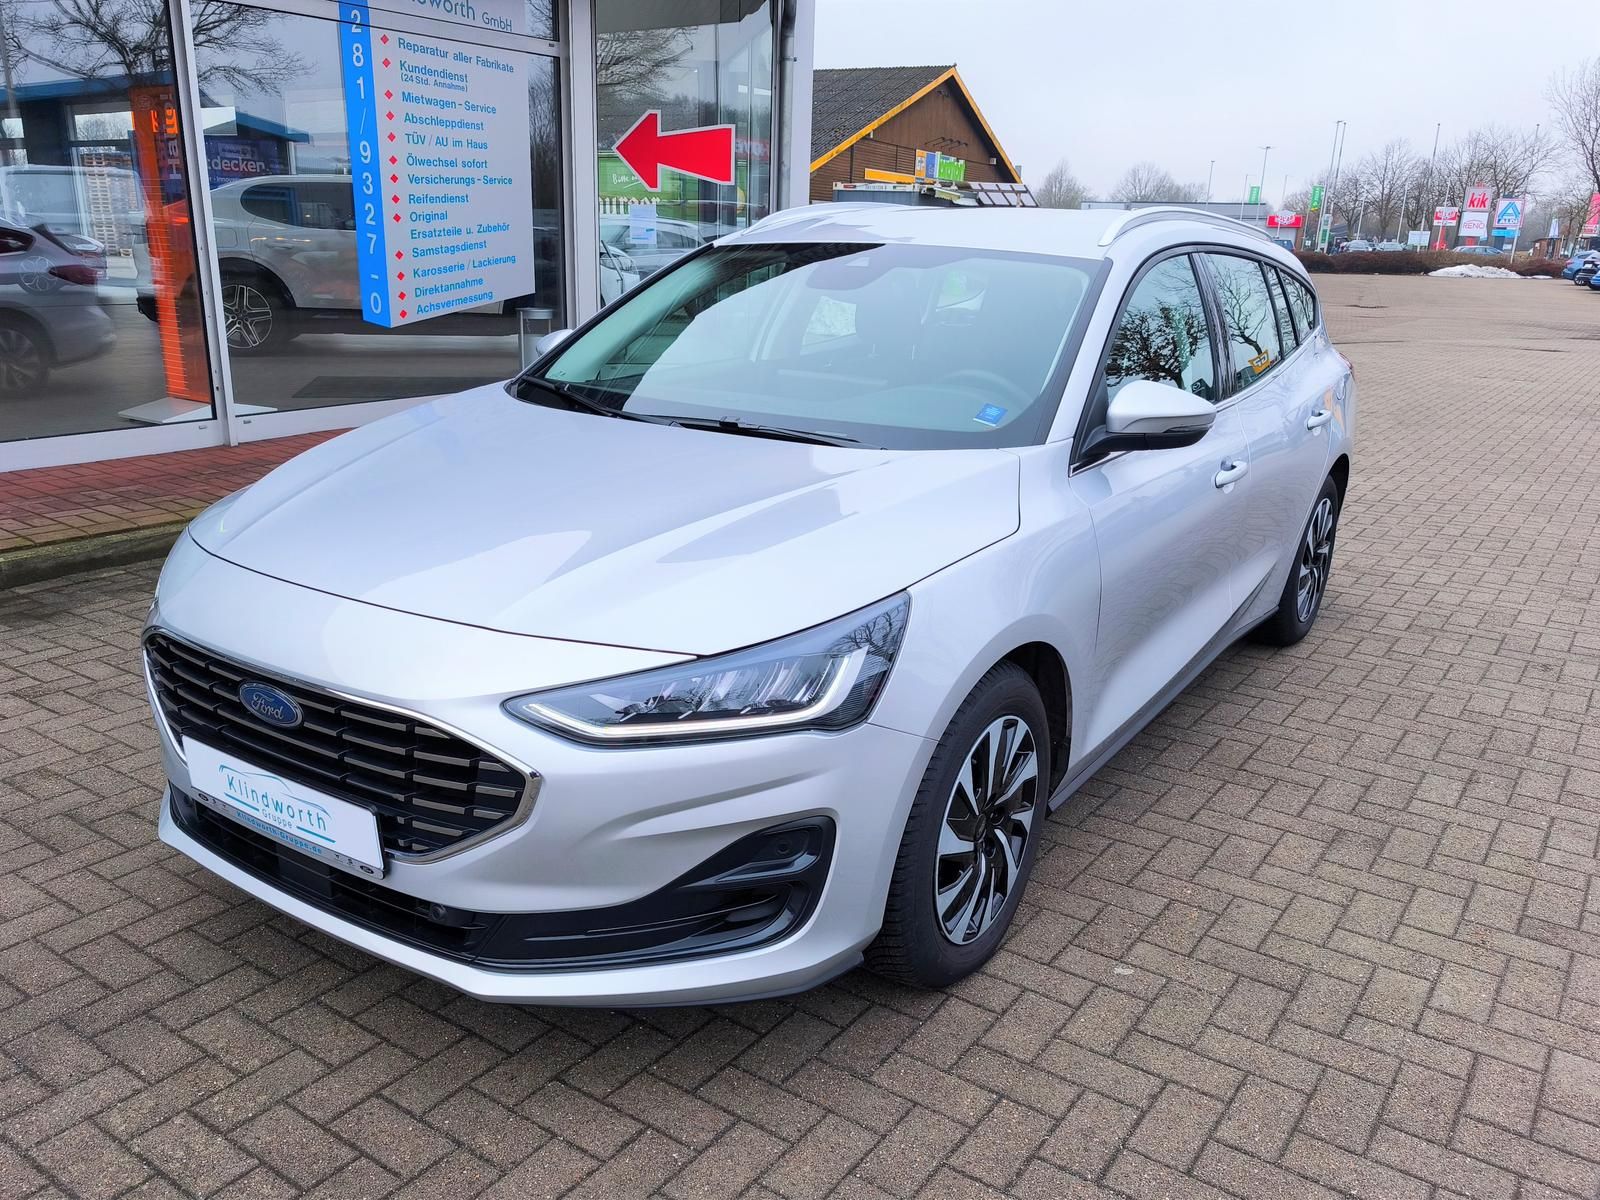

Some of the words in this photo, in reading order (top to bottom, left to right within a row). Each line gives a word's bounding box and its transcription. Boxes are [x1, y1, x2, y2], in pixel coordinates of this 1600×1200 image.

[481, 12, 513, 32] GmbH
[397, 37, 449, 59] Reparatur
[452, 51, 472, 64] aller
[475, 55, 515, 74] Fabrikate
[399, 60, 468, 83] Kundendienst
[400, 73, 414, 83] (24
[414, 75, 431, 86] Std.
[433, 79, 468, 93] Annahme)
[403, 112, 485, 131] Abschleppdienst
[405, 131, 426, 146] TÜV
[434, 136, 449, 148] AU
[452, 137, 463, 148] im
[466, 138, 488, 150] Haus
[406, 152, 458, 168] Ölwechsel
[461, 158, 488, 169] sofort
[408, 193, 470, 205] Reifendienst
[409, 210, 448, 224] Original
[410, 227, 463, 240] Ersatzteile
[465, 226, 474, 235] u.
[476, 221, 511, 234] Zubehör
[411, 239, 488, 259] Samstagsdienst
[414, 276, 484, 298] Direktannahme
[416, 290, 494, 315] Achsvermessung
[251, 692, 285, 721] Ford
[226, 774, 327, 832] Klindworth
[261, 808, 293, 829] Gruppe
